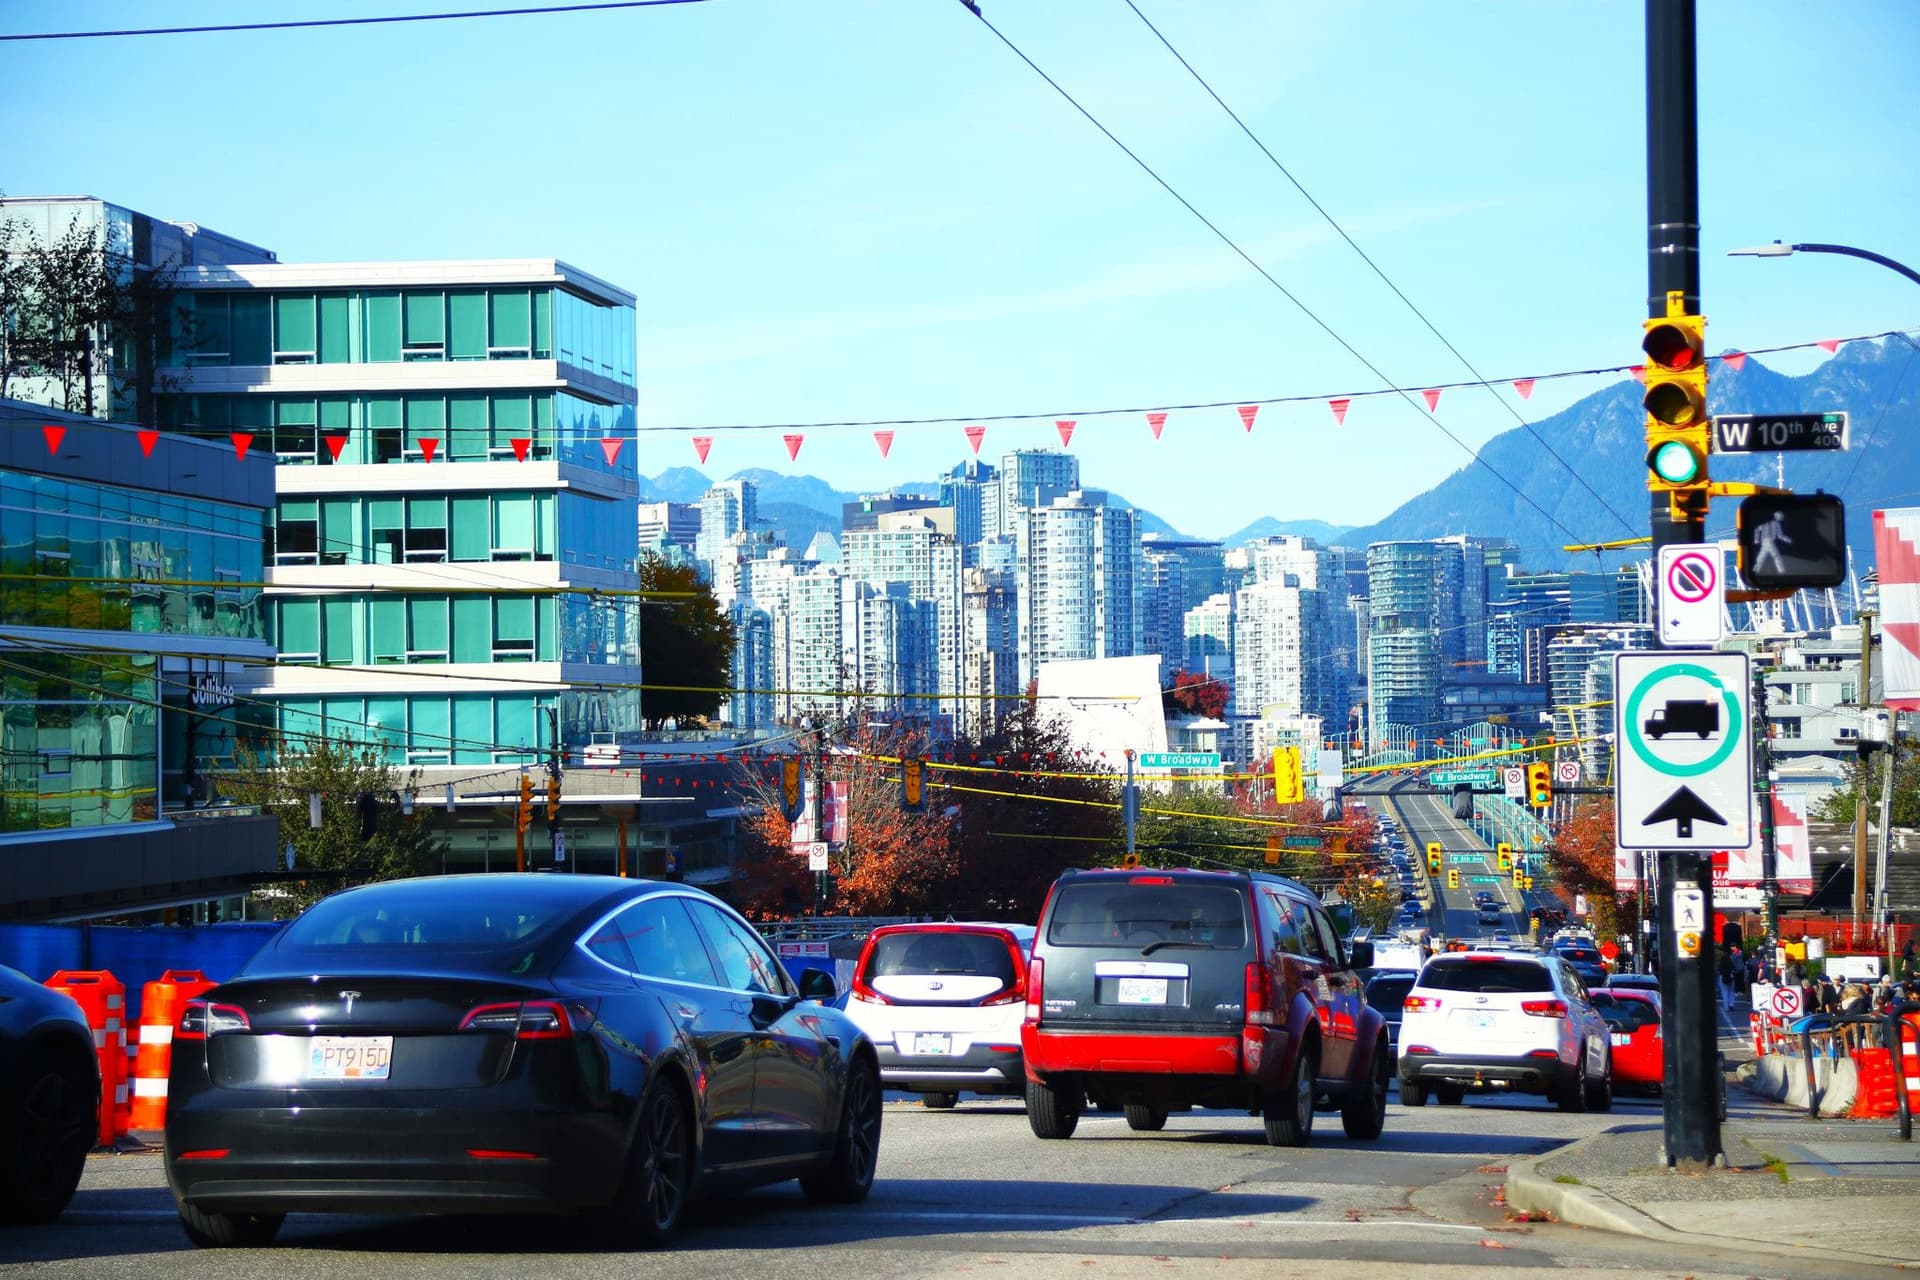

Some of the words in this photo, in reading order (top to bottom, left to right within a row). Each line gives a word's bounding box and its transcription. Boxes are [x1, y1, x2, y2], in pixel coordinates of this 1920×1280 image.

[1722, 423, 1749, 446] W
[1758, 421, 1803, 445] 10th
[1811, 421, 1838, 433] Ave
[1814, 434, 1840, 446] 400
[192, 676, 234, 704] Jollibee
[1146, 754, 1156, 764] W
[1161, 754, 1213, 767] Broadway
[1436, 772, 1444, 782] W
[1447, 771, 1491, 782] Broadway
